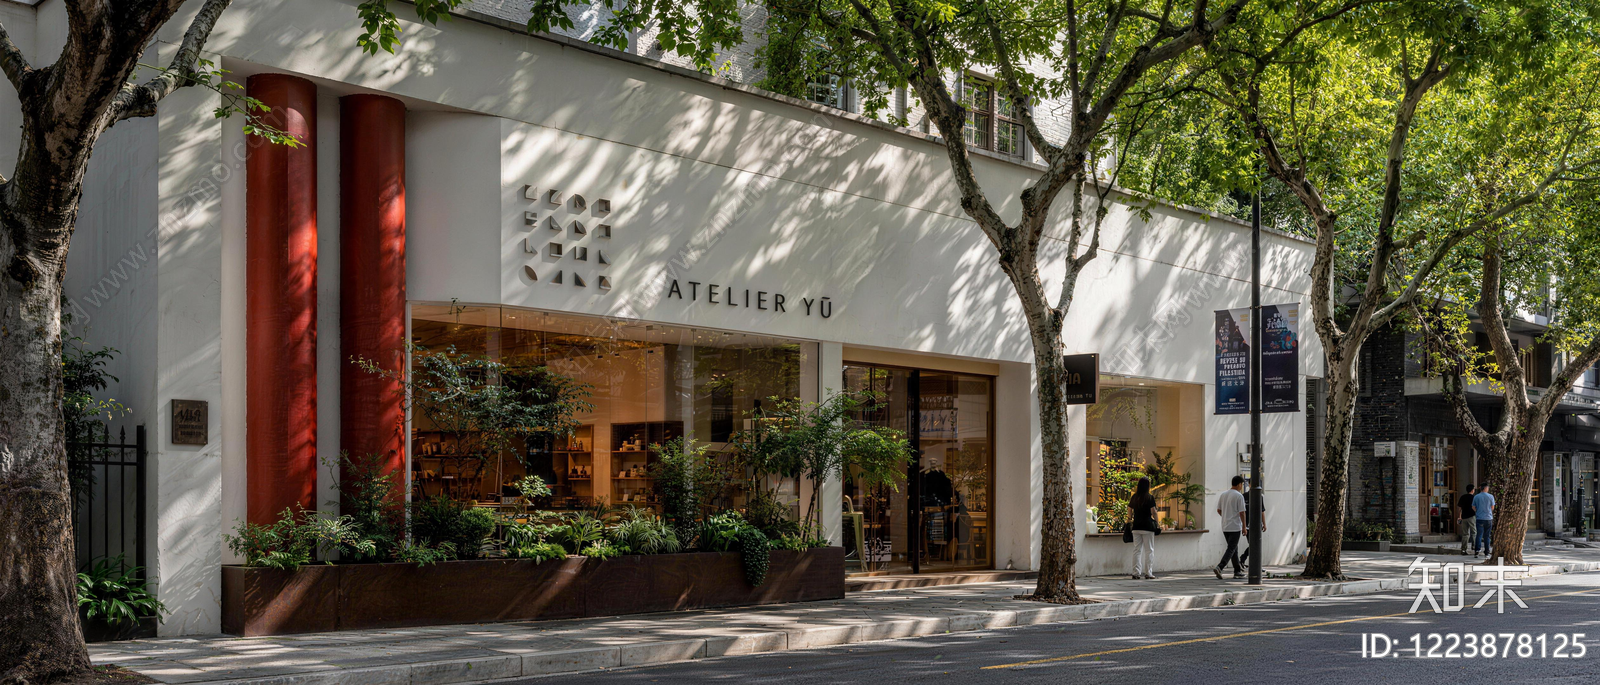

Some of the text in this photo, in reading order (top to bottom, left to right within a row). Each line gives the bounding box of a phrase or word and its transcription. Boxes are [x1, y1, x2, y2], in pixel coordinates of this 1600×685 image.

[668, 279, 832, 319] ATELIER YŪ
[1067, 372, 1081, 385] IA
